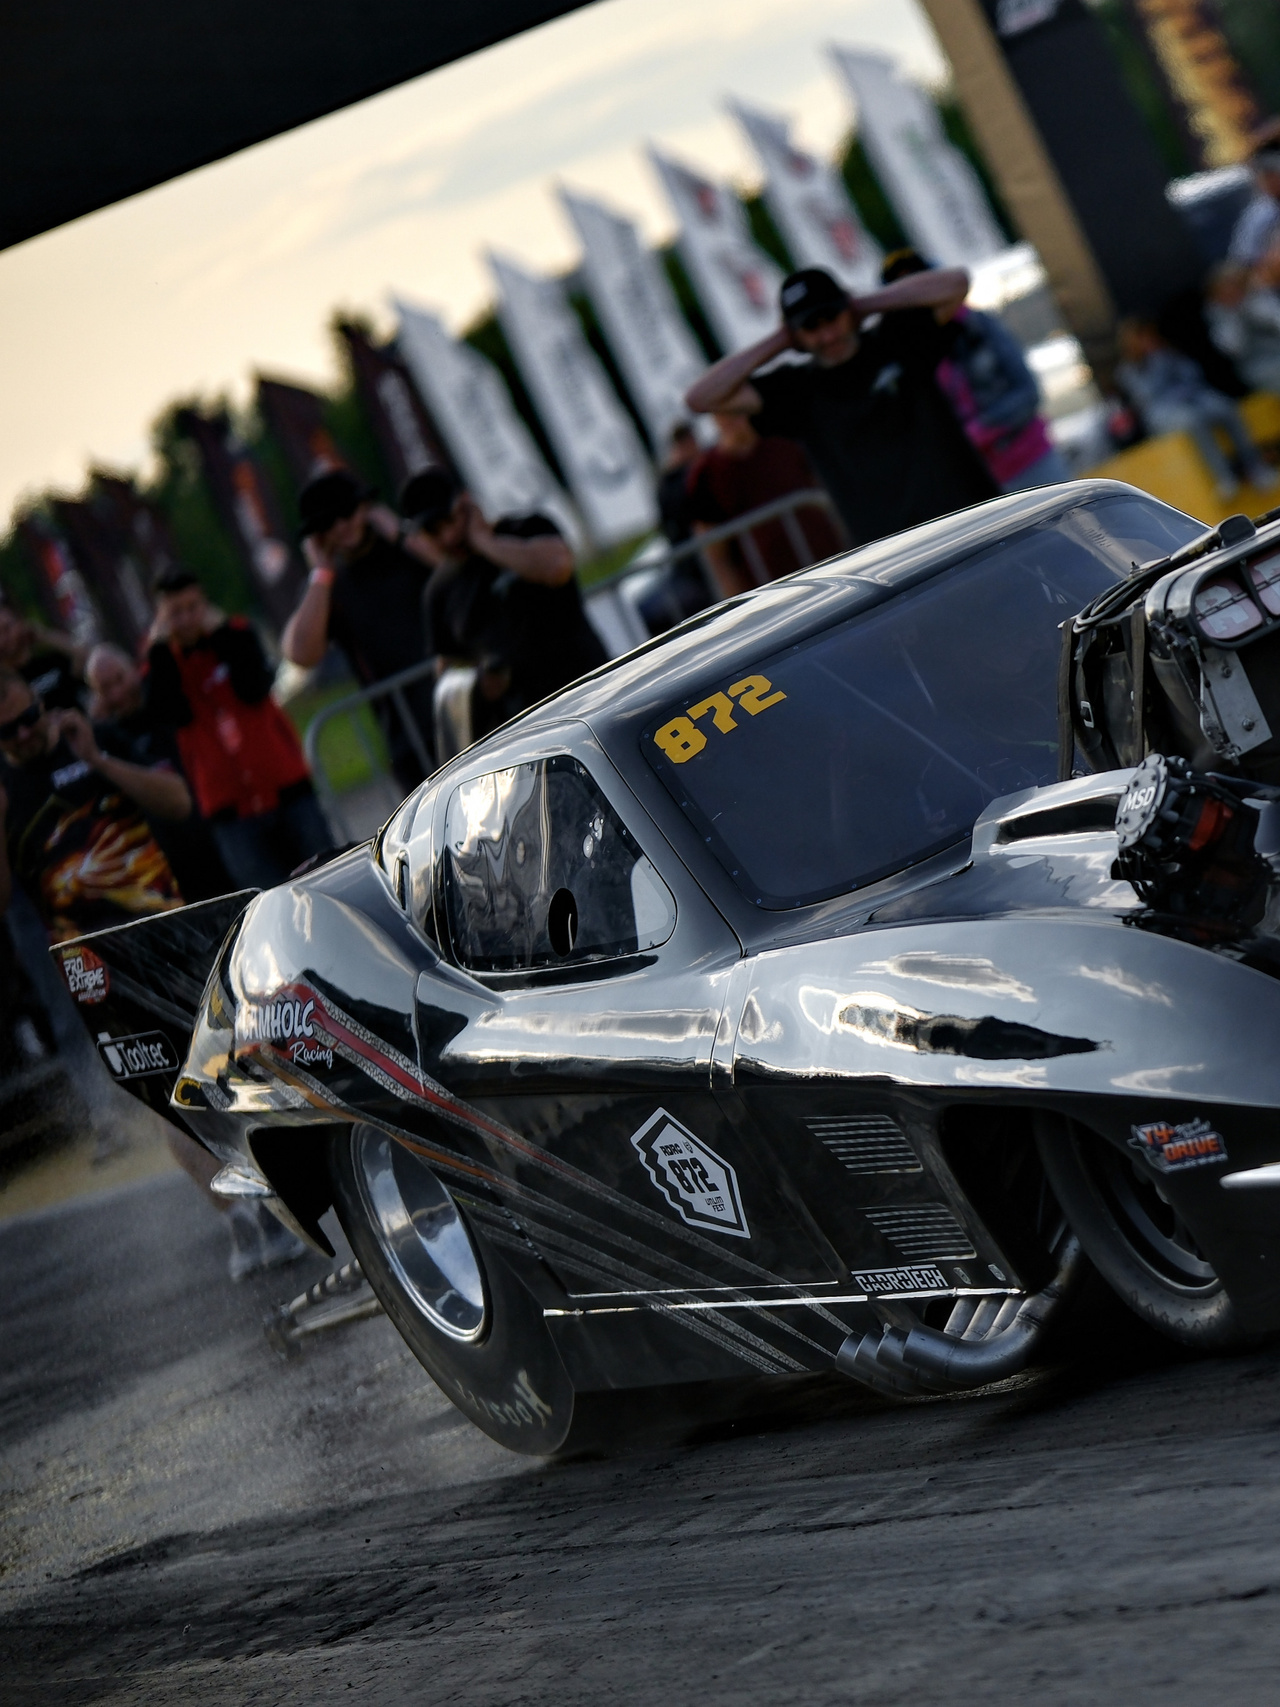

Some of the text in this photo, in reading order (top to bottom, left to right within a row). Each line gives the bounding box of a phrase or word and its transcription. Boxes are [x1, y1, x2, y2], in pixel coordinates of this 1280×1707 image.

[653, 674, 788, 764] 872
[1122, 786, 1157, 812] MSD
[63, 956, 85, 977] PRO
[68, 967, 105, 993] EXTREME
[115, 1039, 170, 1077] Tooltec
[289, 1041, 333, 1069] Racing
[1162, 1133, 1221, 1162] DRIVE
[667, 1157, 720, 1194] 872
[712, 1204, 726, 1213] FEST
